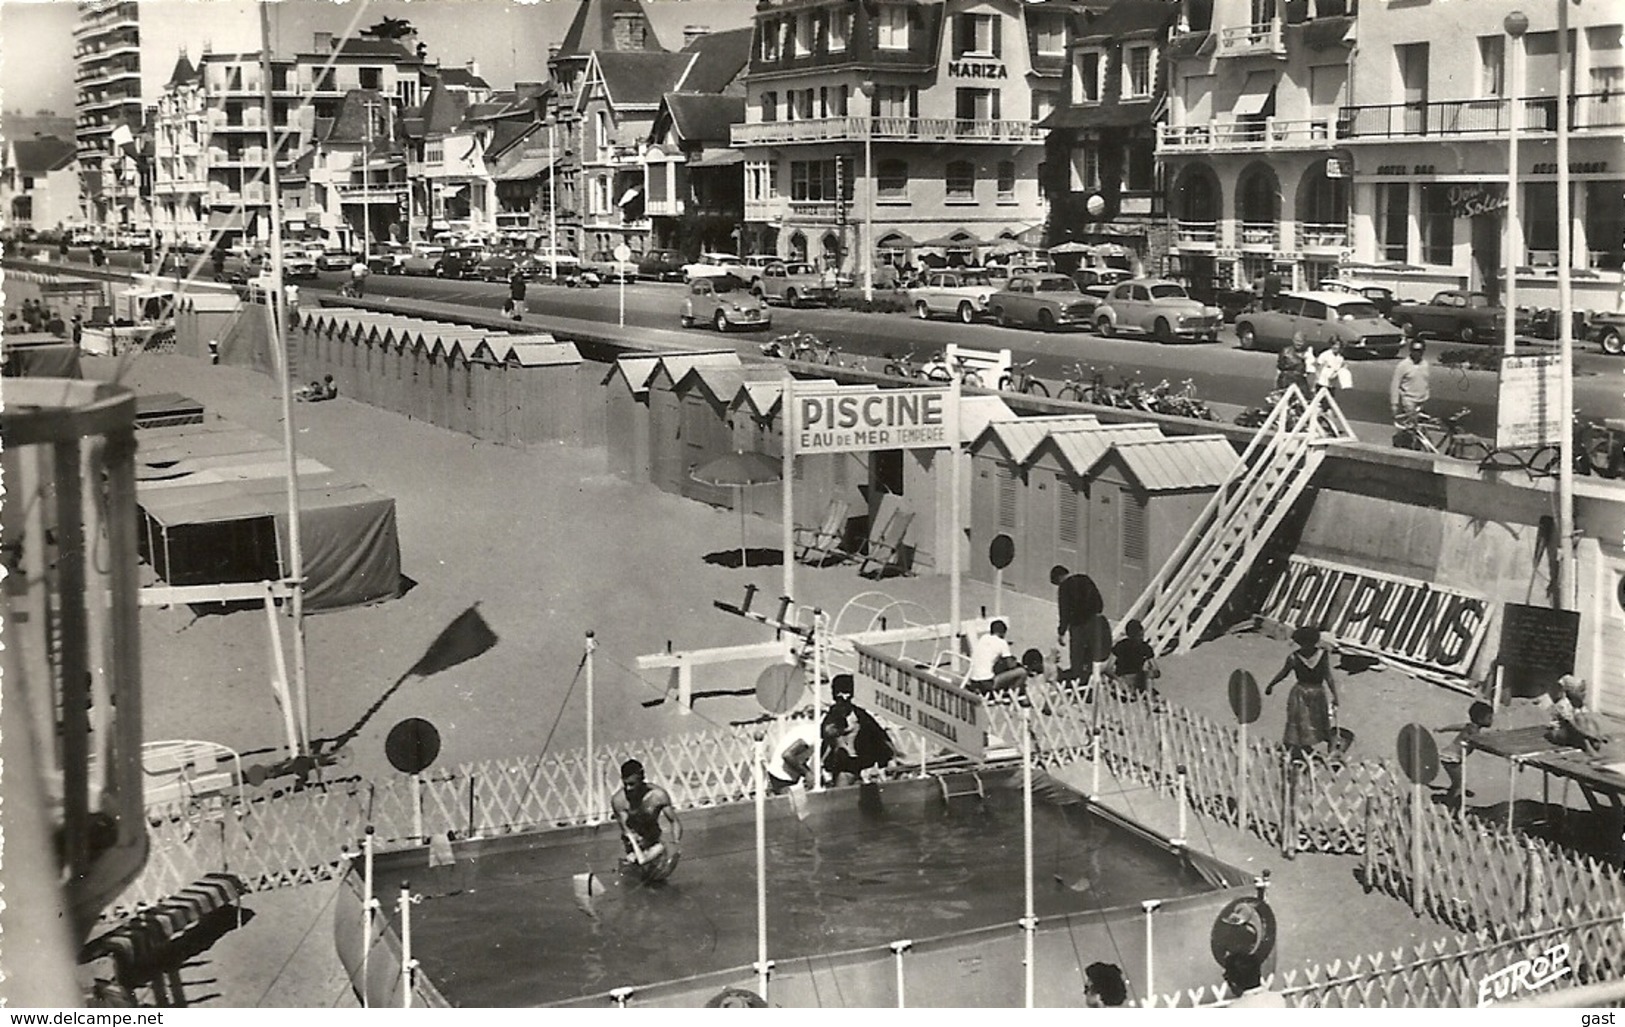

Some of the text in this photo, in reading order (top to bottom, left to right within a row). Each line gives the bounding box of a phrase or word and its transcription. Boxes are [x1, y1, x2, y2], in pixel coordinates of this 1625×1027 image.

[948, 62, 1008, 79] MARIZA
[801, 394, 943, 430] PISCINE
[801, 432, 834, 447] EAU
[854, 430, 890, 445] MER
[858, 649, 977, 726] ECOLE DE NATATION
[875, 689, 912, 721] PISCINE
